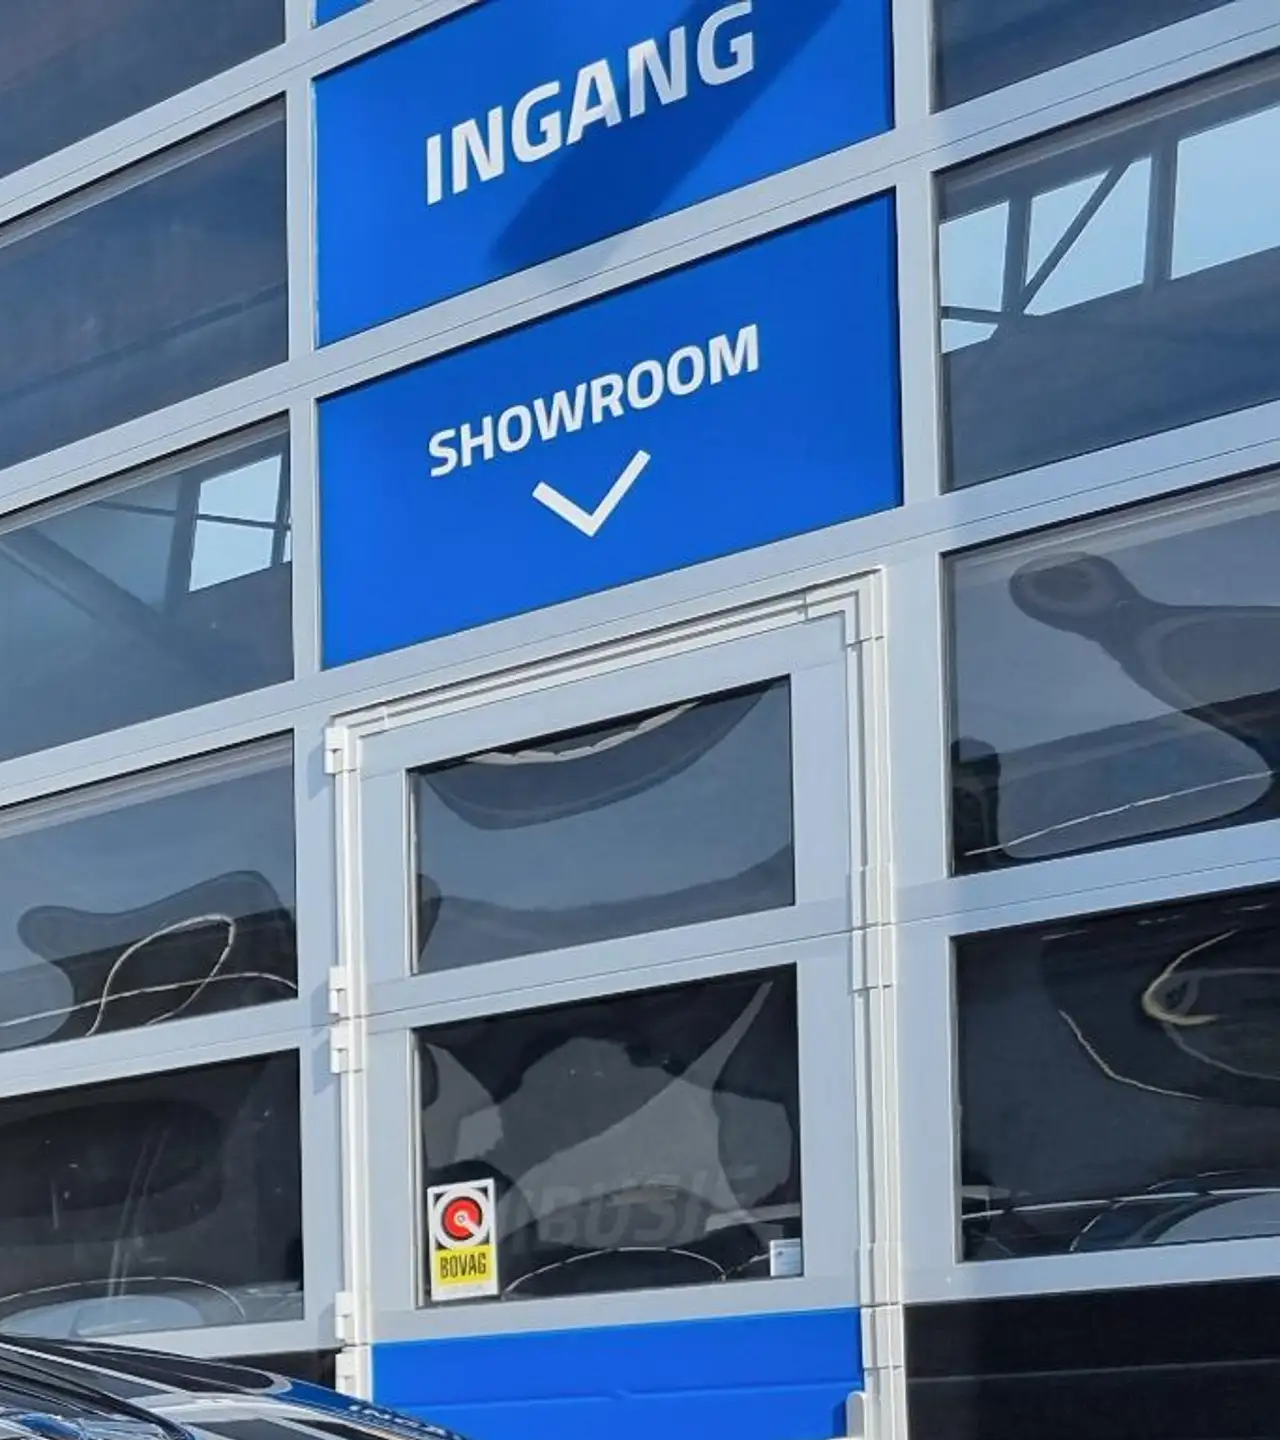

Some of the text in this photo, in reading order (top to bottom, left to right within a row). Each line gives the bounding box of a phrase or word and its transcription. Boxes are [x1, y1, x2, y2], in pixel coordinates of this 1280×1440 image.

[426, 1, 755, 205] INGANG
[428, 324, 760, 478] SHOWROOM
[440, 1252, 487, 1279] BOVAG
